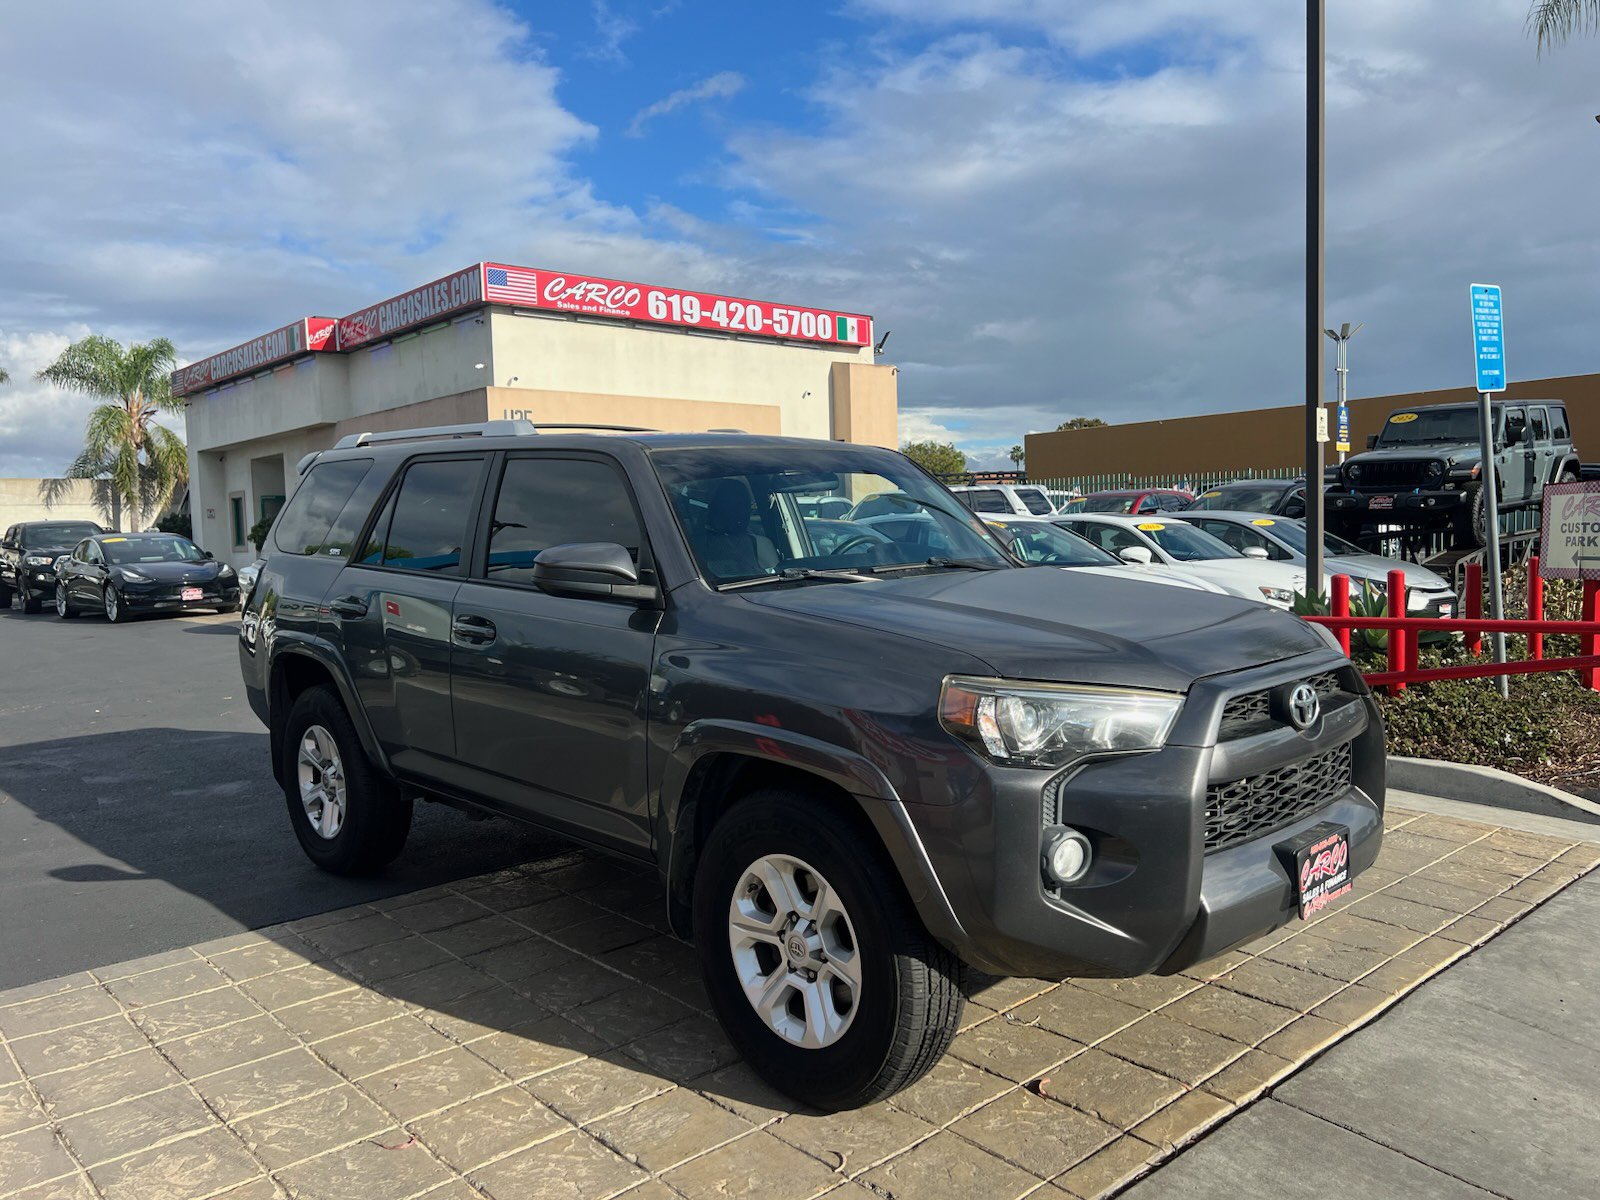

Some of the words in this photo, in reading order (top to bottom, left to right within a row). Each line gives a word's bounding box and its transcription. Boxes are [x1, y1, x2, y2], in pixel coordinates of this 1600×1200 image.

[379, 269, 480, 333] CARCOSALES.COM
[543, 277, 641, 309] CARCO
[647, 290, 832, 340] 619-420-5700
[557, 301, 580, 310] Sales
[599, 306, 631, 316] Finance
[210, 331, 288, 380] CARCOSALES.COM
[1565, 536, 1599, 547] PARK
[1300, 841, 1348, 893] CARCO
[1302, 885, 1320, 904] SALES
